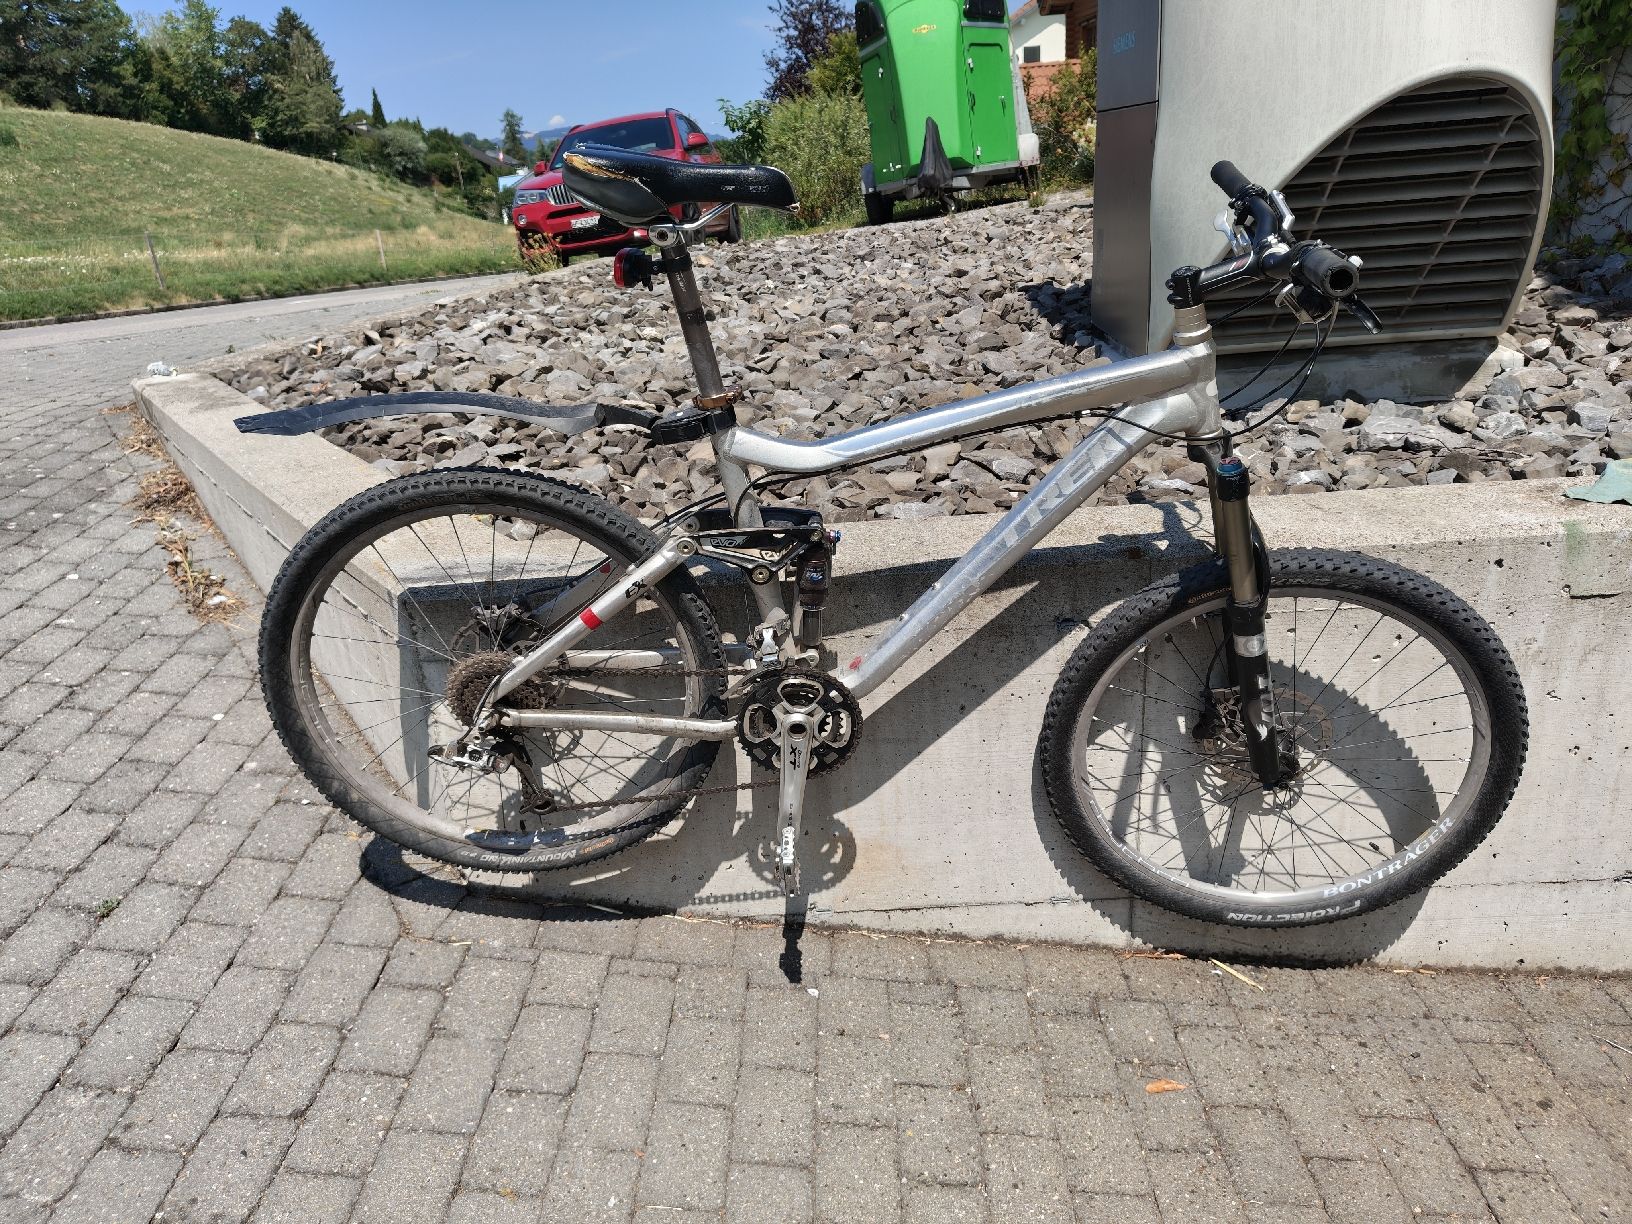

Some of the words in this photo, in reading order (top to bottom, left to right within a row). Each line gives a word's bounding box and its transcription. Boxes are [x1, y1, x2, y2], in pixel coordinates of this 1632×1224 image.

[1000, 427, 1127, 548] TREK
[789, 743, 798, 771] XT
[1323, 816, 1455, 898] BONTRAGER
